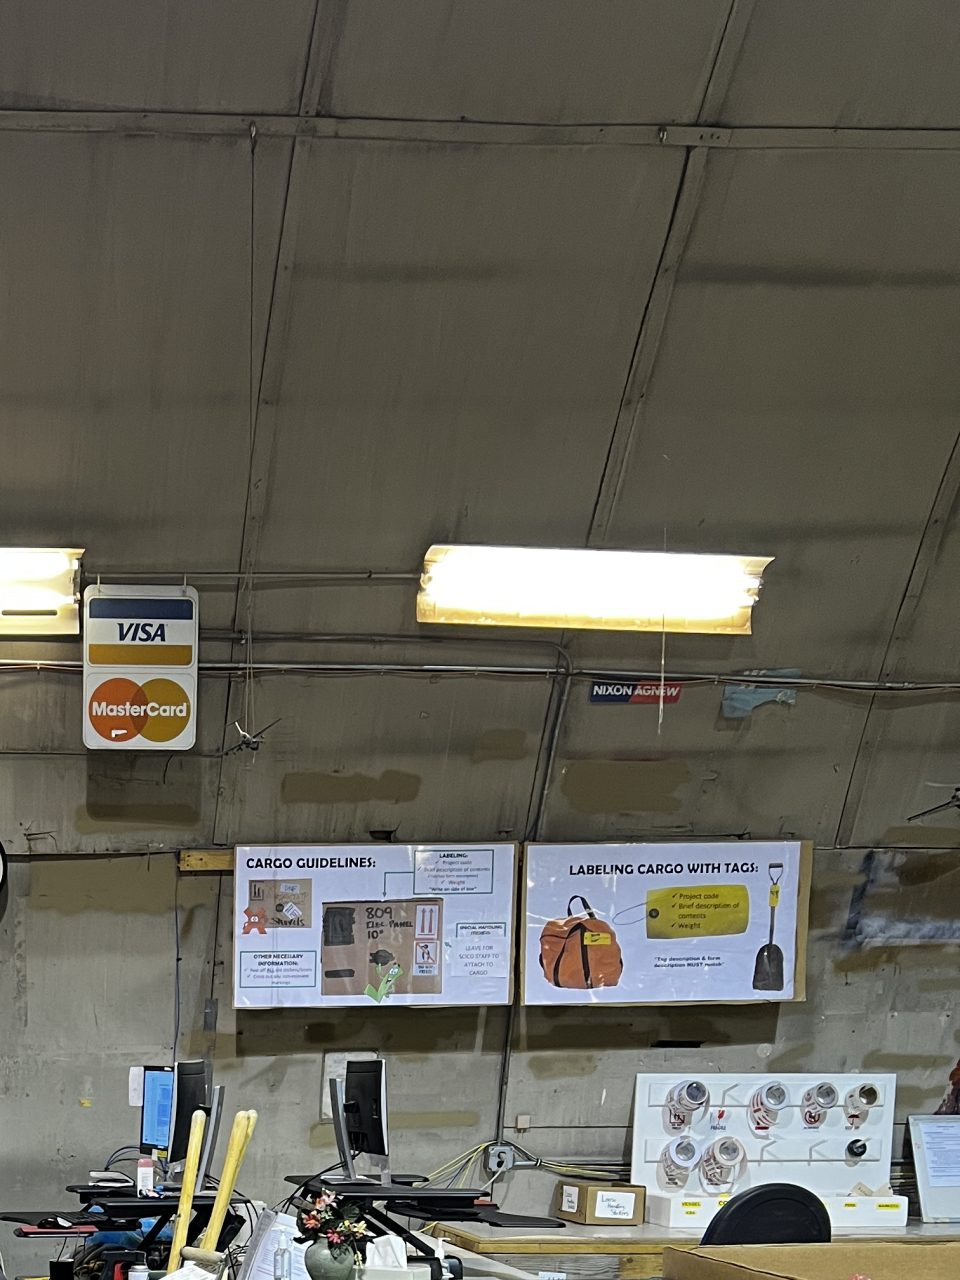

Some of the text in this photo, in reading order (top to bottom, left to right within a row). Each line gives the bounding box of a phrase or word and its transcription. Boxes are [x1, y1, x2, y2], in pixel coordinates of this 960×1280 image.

[117, 623, 166, 642] VISA
[593, 685, 680, 697] NIXON AGNEW
[92, 701, 188, 717] MasterCard
[246, 857, 376, 869] CARGO GUIDELINES:
[569, 862, 759, 876] LABELING CARGO WITH TAGS:
[679, 892, 719, 901] Project code
[679, 902, 694, 910] Brief
[695, 902, 731, 911] description
[365, 906, 393, 920] 809
[678, 922, 701, 930] Weight
